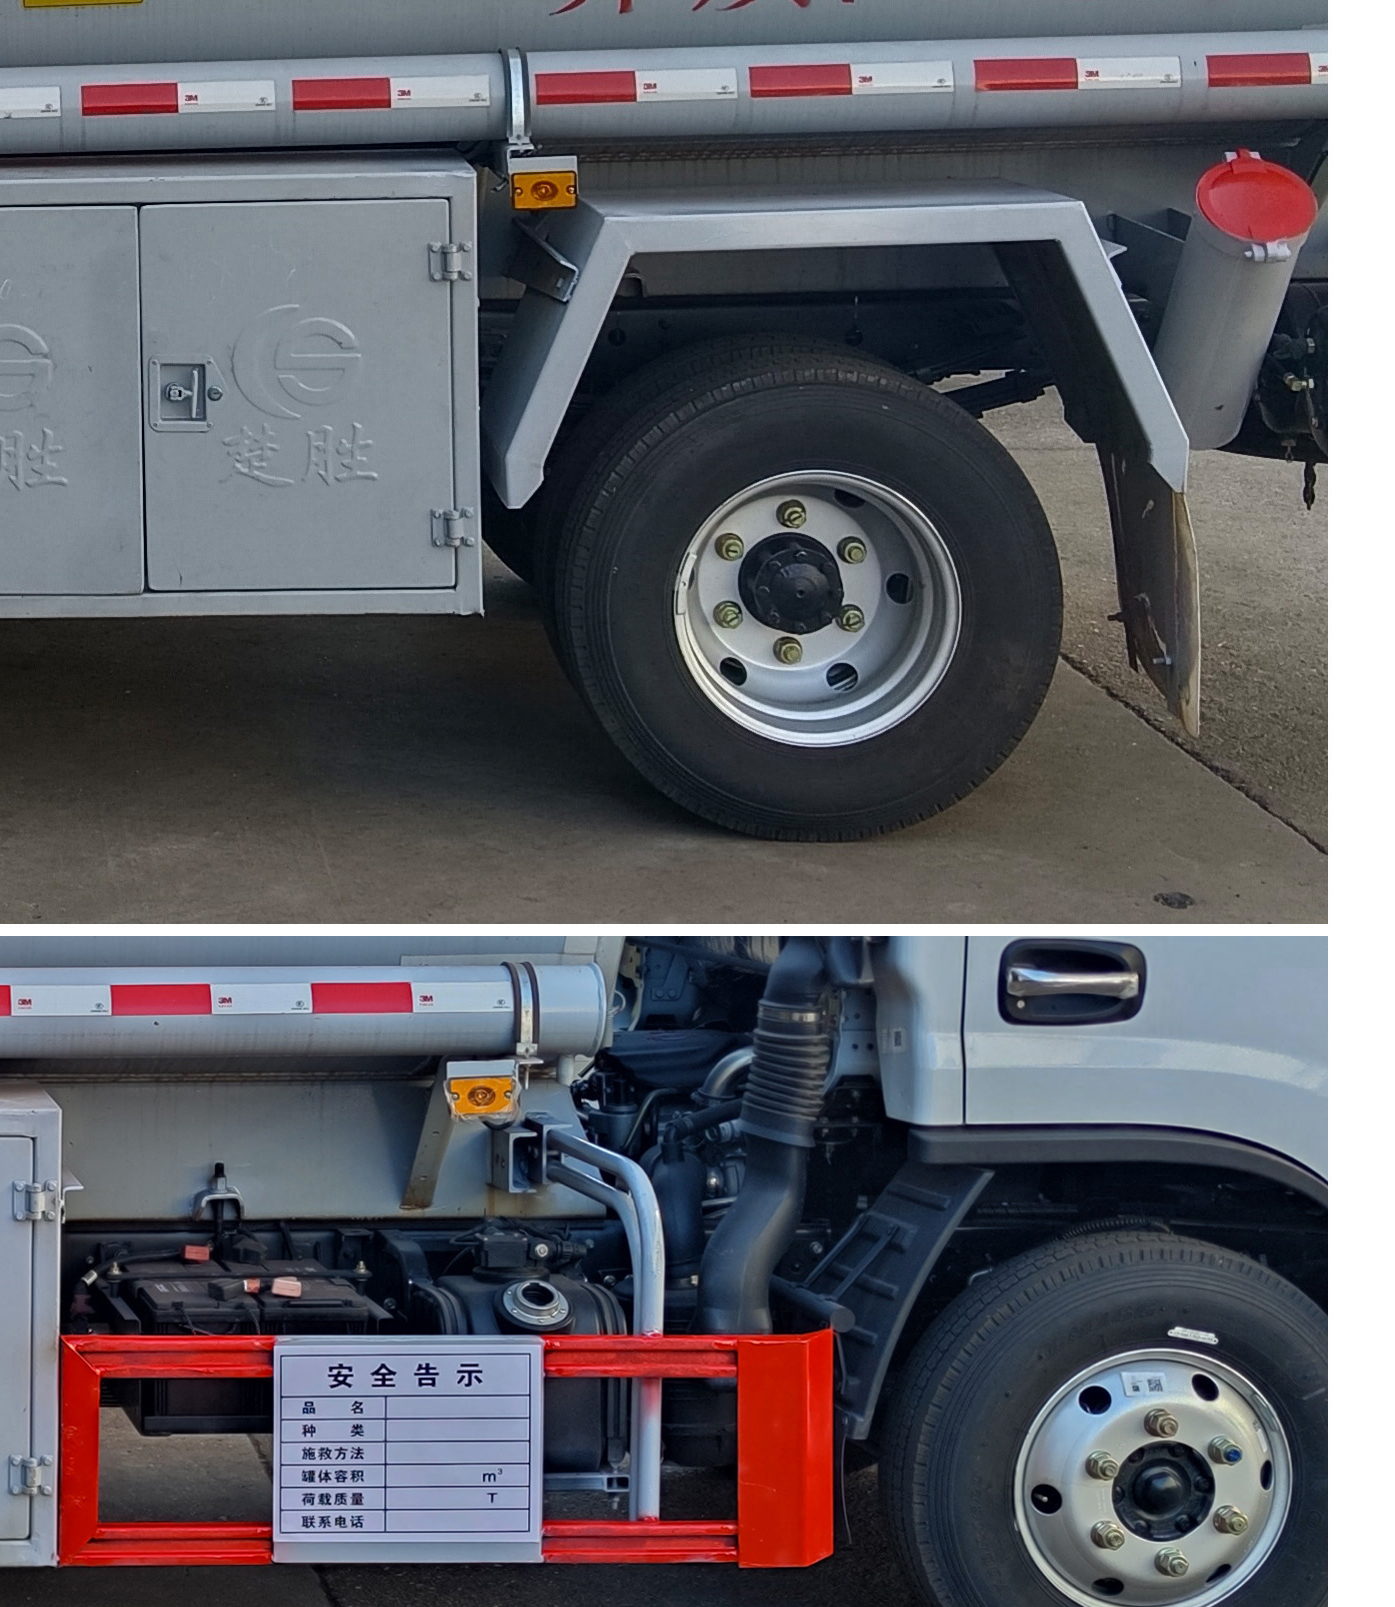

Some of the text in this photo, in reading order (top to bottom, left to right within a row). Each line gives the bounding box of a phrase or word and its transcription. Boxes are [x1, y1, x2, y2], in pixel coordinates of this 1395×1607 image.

[218, 422, 378, 488] 楚胜
[328, 1363, 483, 1388] 安全告示
[302, 1447, 364, 1460] 施救方法
[302, 1470, 364, 1482] 罐体容积
[302, 1493, 364, 1506] 荷载质量
[487, 1493, 497, 1503] T
[302, 1515, 364, 1528] 联系电话
